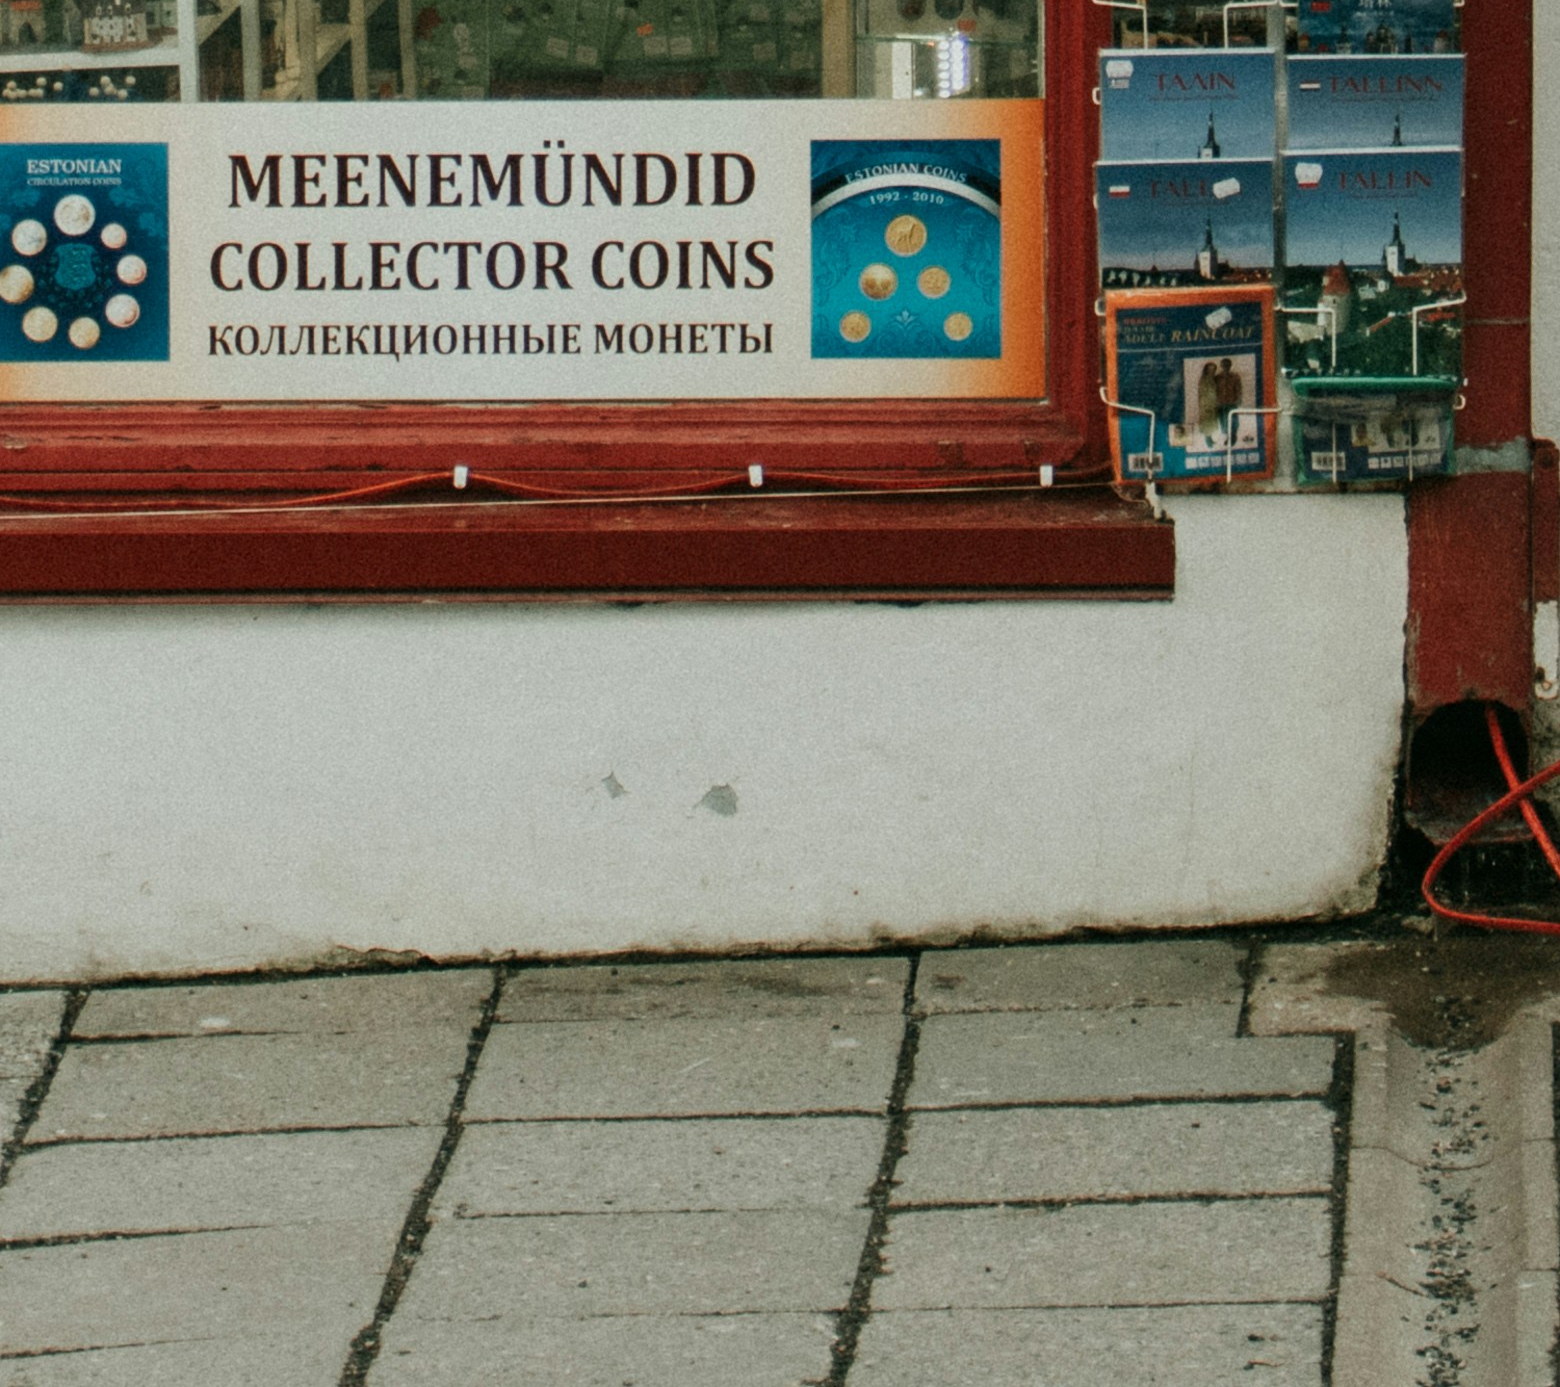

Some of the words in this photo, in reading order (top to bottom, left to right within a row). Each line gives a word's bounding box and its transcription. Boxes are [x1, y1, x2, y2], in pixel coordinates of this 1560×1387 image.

[1329, 74, 1442, 93] TALLINN
[26, 159, 122, 174] ESTONIAN
[227, 140, 756, 209] MEENEMÜNDID
[845, 163, 919, 184] ESTONIAN
[922, 165, 968, 183] COINS
[92, 177, 122, 187] COINS
[1338, 170, 1432, 188] TALLIN
[870, 191, 901, 205] 1992
[912, 191, 944, 205] 2010
[209, 241, 573, 292] COLLECTOR
[591, 240, 776, 291] COINS
[1170, 325, 1255, 343] RAINCOAT
[207, 323, 582, 365] КОЛЛЕКЦИОННЫЕ
[593, 322, 775, 356] МОНЕТЫ
